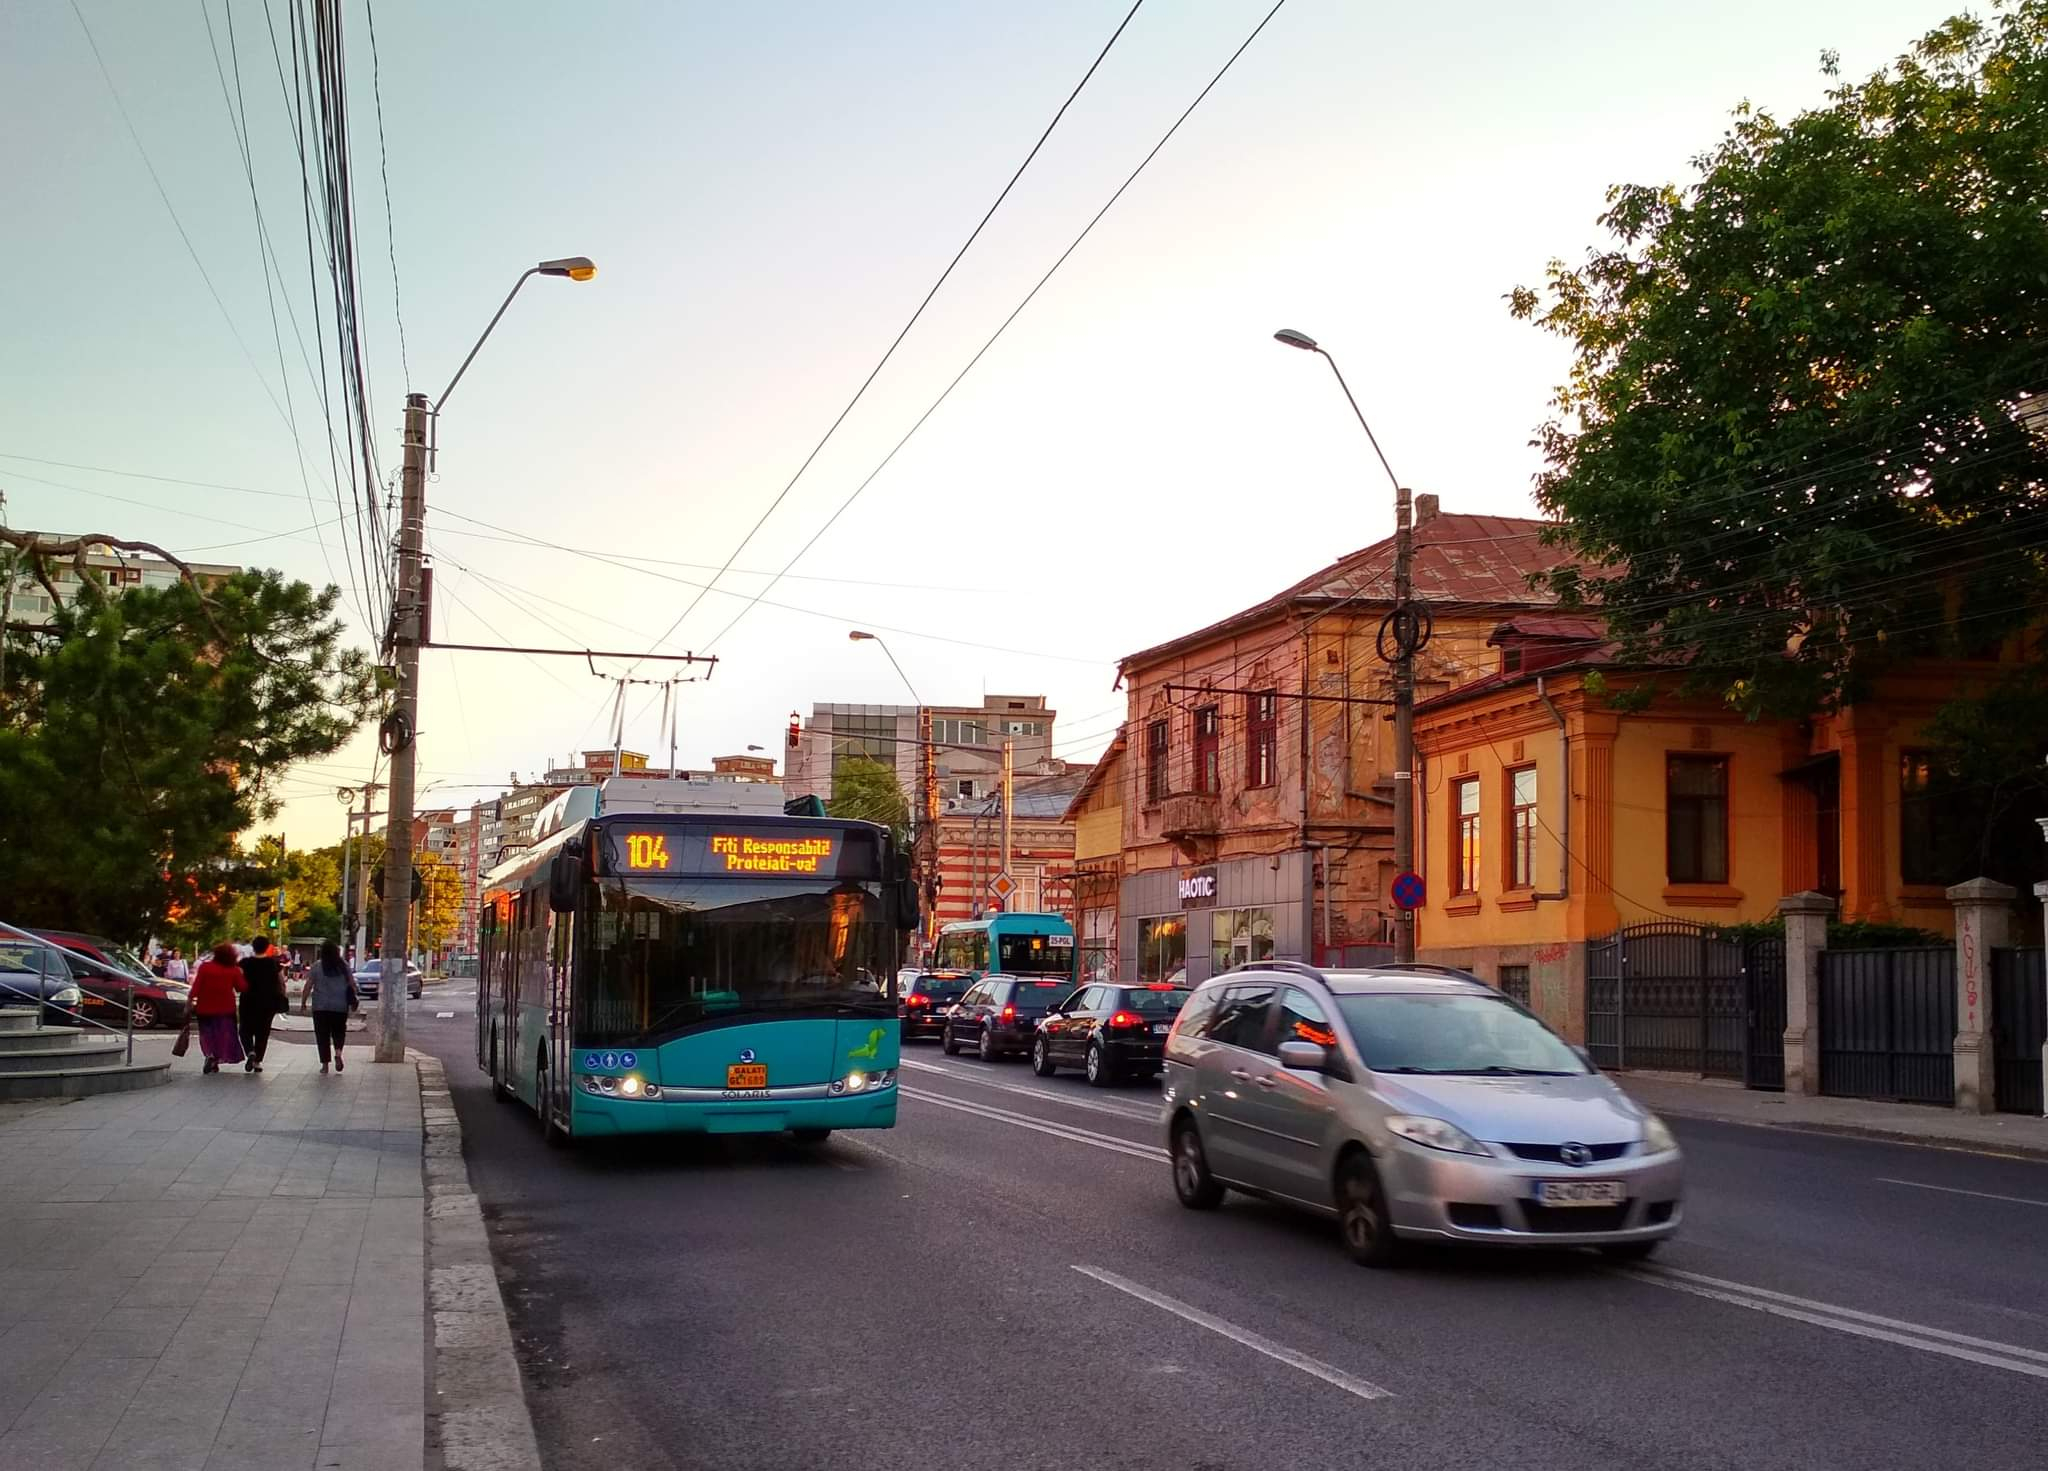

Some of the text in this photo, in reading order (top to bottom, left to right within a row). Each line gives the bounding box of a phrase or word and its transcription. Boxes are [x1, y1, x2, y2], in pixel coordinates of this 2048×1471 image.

[626, 835, 668, 869] 104
[713, 837, 739, 854] Fiti
[721, 1091, 771, 1099] SOLARIS
